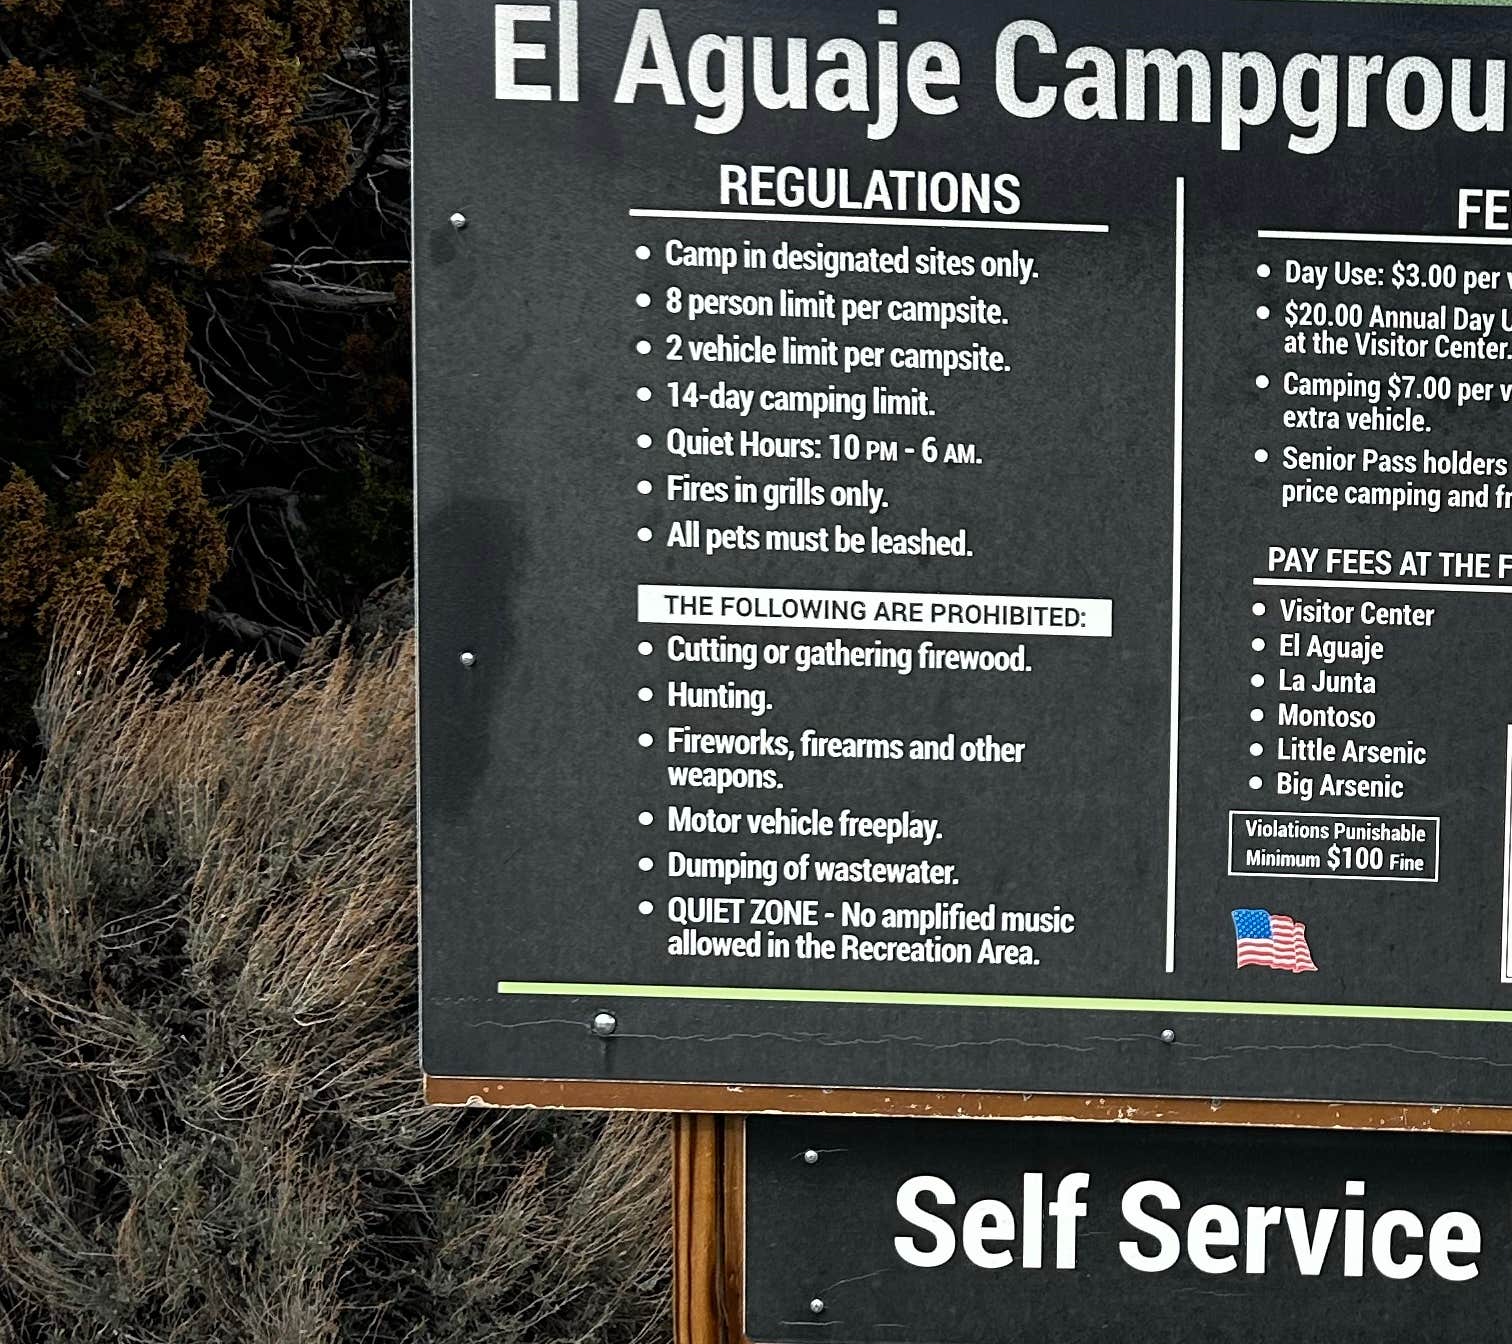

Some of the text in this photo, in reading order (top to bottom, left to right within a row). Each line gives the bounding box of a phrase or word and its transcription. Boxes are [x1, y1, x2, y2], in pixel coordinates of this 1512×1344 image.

[495, 0, 579, 102] El
[614, 9, 960, 140] Aguaje
[720, 164, 1020, 214] REGULATIONS
[666, 239, 1038, 284] Camp in designated sites only.
[1286, 260, 1328, 290] Day
[1335, 261, 1384, 285] Use:
[1392, 260, 1456, 289] $3.00
[1464, 271, 1500, 294] per
[1285, 299, 1362, 328] $20.00
[1369, 305, 1446, 329] Annual
[1454, 307, 1495, 337] Day
[667, 381, 935, 420] 14-day camping limit.
[667, 428, 734, 457] Quiet
[740, 431, 821, 458] Hours:
[829, 434, 859, 460] 10
[866, 441, 897, 461] PM
[922, 437, 938, 462] 6
[943, 444, 982, 464] AM.
[1283, 446, 1356, 471] Senior
[1363, 449, 1416, 473] Pass
[1424, 449, 1507, 476] holders
[668, 474, 888, 514] Fires in grills only.
[1269, 547, 1319, 572] PAY
[1327, 549, 1392, 575] FEES
[1399, 551, 1432, 576] AT
[1439, 552, 1490, 578] THE
[664, 595, 1086, 627] THE FOLLOWING ARE PROHIBITED:
[1280, 598, 1435, 626] Visitor Center
[1280, 633, 1383, 665] El Aguaje
[1279, 669, 1375, 693] La Junta
[668, 682, 772, 716] Hunting.
[1279, 703, 1375, 728] Montoso
[668, 727, 1025, 762] Fireworks, firearms and other
[1278, 737, 1426, 764] Little Arsenic
[668, 767, 783, 794] weapons.
[1277, 771, 1403, 801] Big Arsenic
[1246, 819, 1426, 842] Violations Punishable
[669, 852, 958, 886] Dumping of wastewater.
[1246, 843, 1424, 871] Minimum $100 Fine
[668, 897, 745, 925] QUIET
[750, 899, 818, 925] ZONE
[842, 902, 876, 927] No
[882, 903, 995, 935] amplified
[1001, 906, 1074, 933] music
[894, 1173, 1090, 1269] Self
[1119, 1180, 1481, 1281] Service
